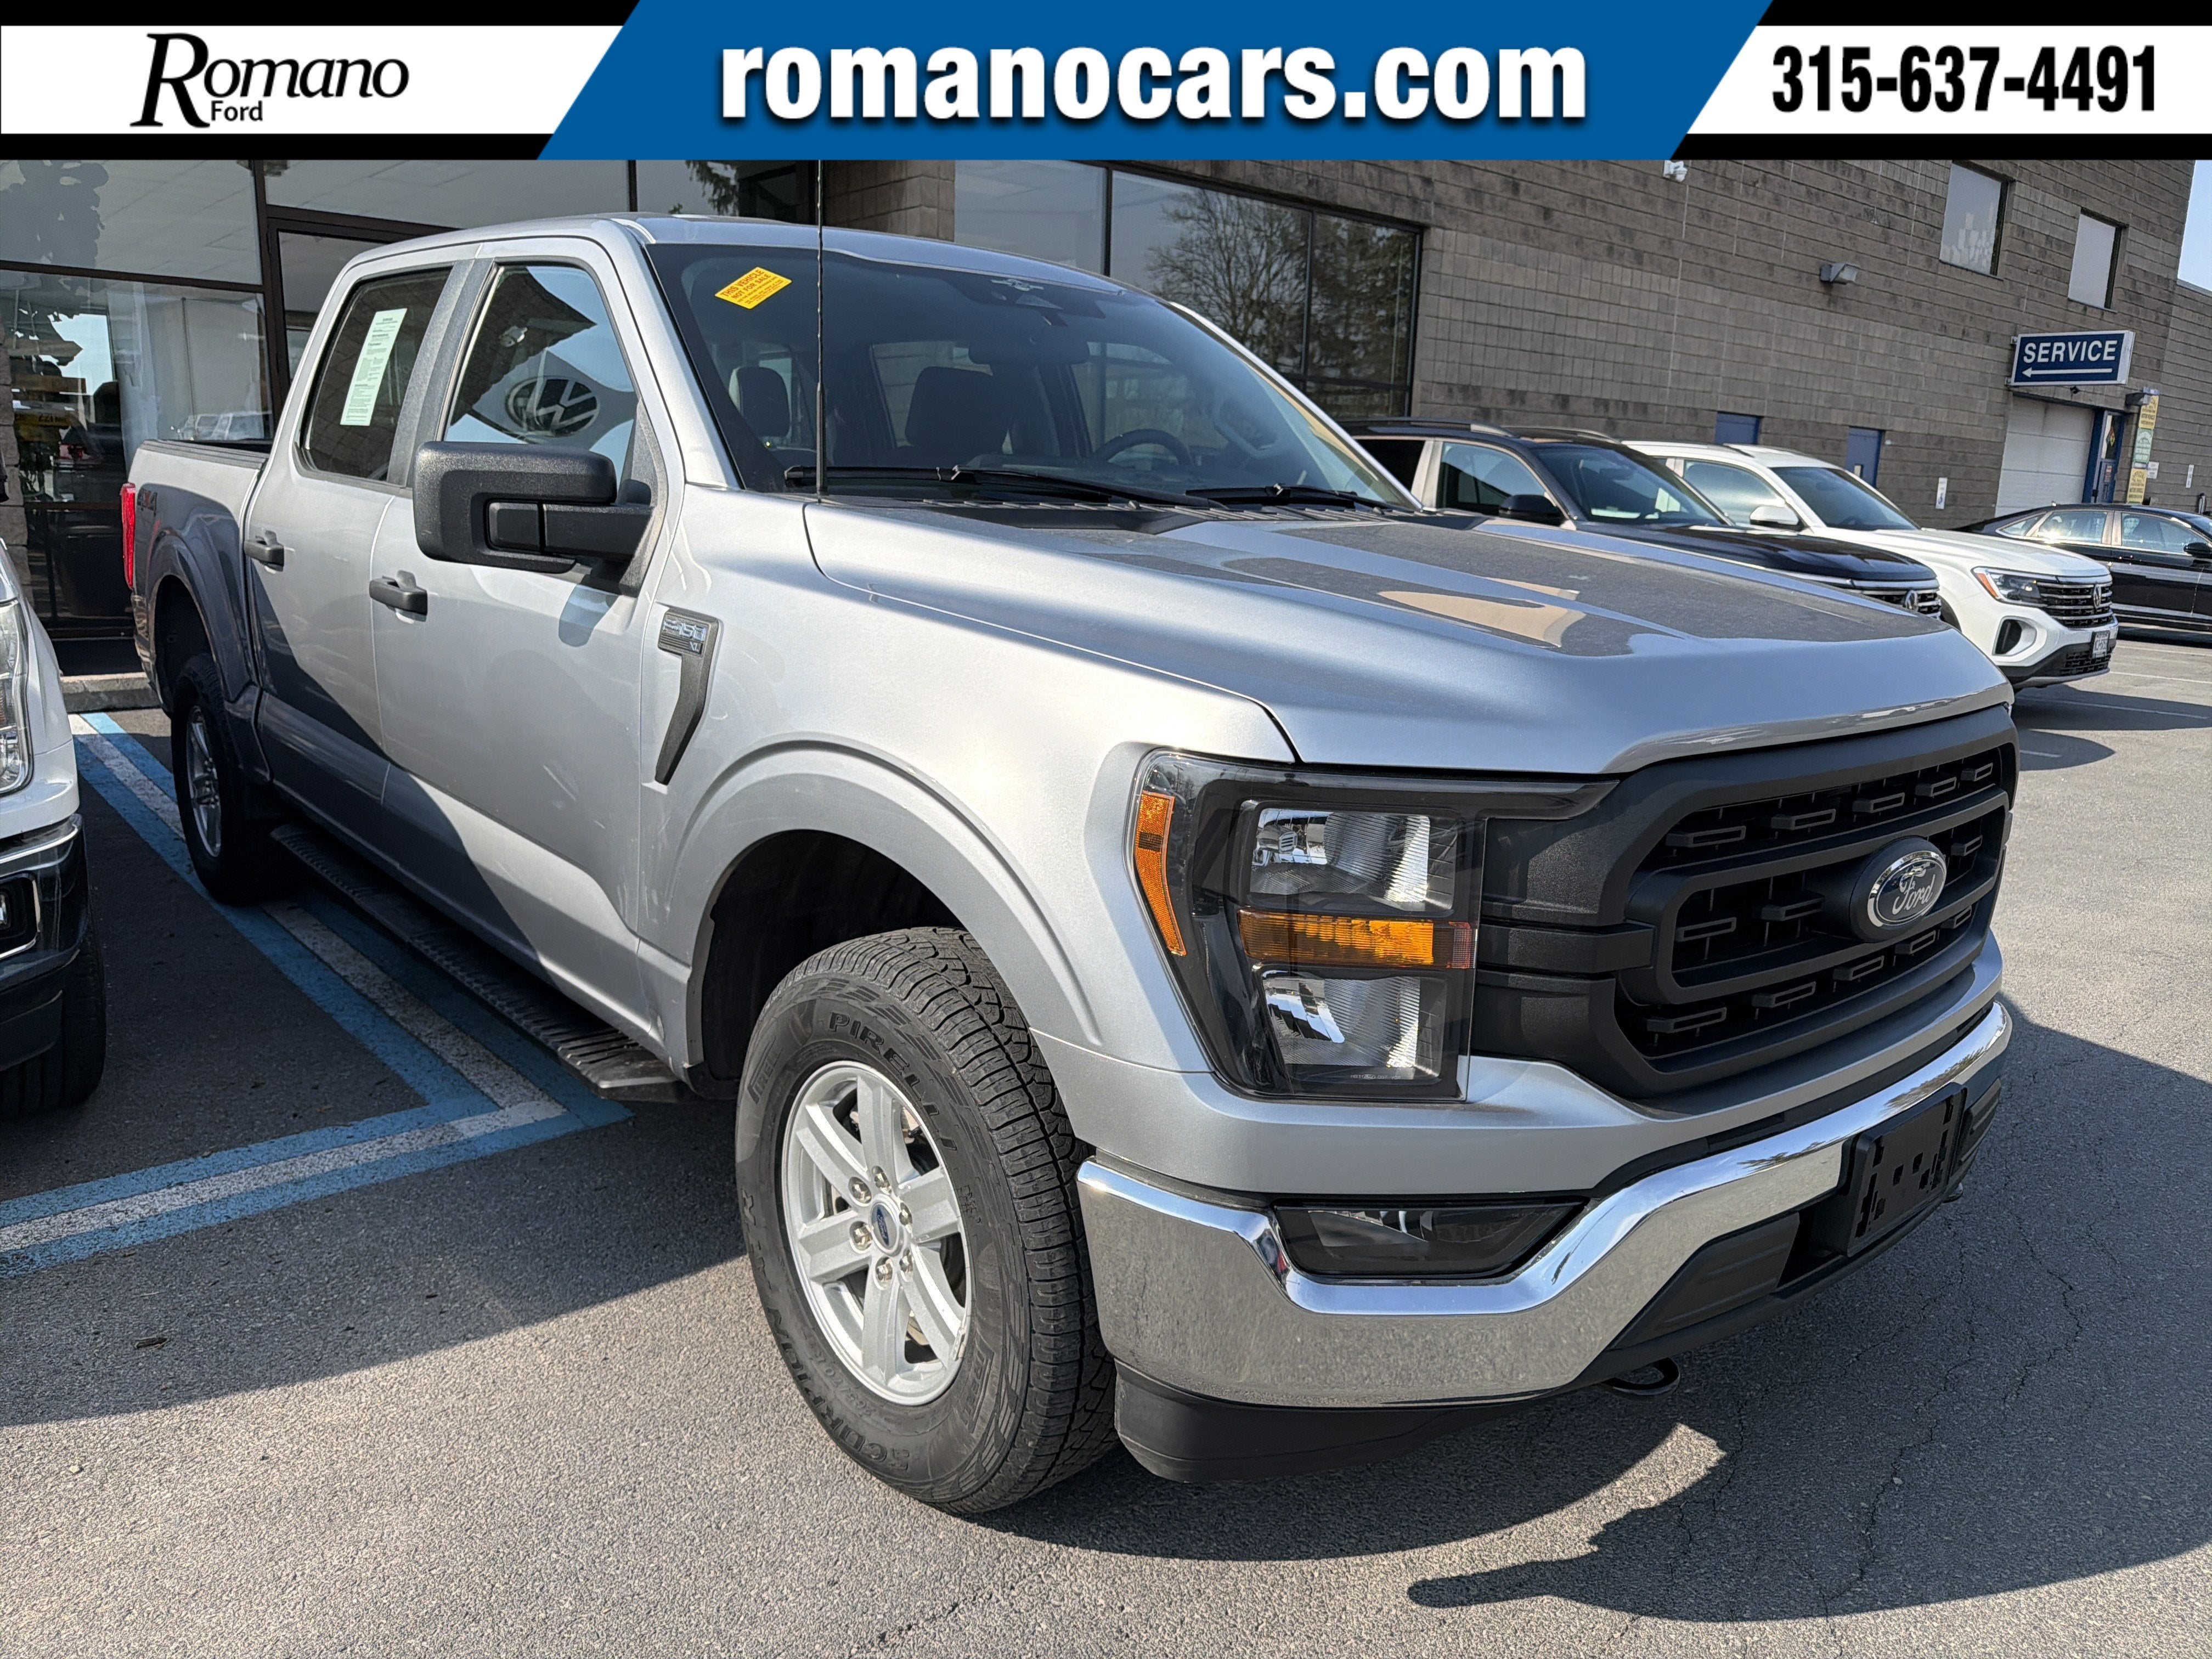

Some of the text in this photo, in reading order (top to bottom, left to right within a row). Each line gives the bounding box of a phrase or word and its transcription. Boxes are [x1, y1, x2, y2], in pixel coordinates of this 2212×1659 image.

[735, 269, 765, 287] VEHICLE
[2023, 340, 2118, 364] SERVICE
[1892, 867, 1936, 915] Ford
[829, 1012, 958, 1152] PIRELLI
